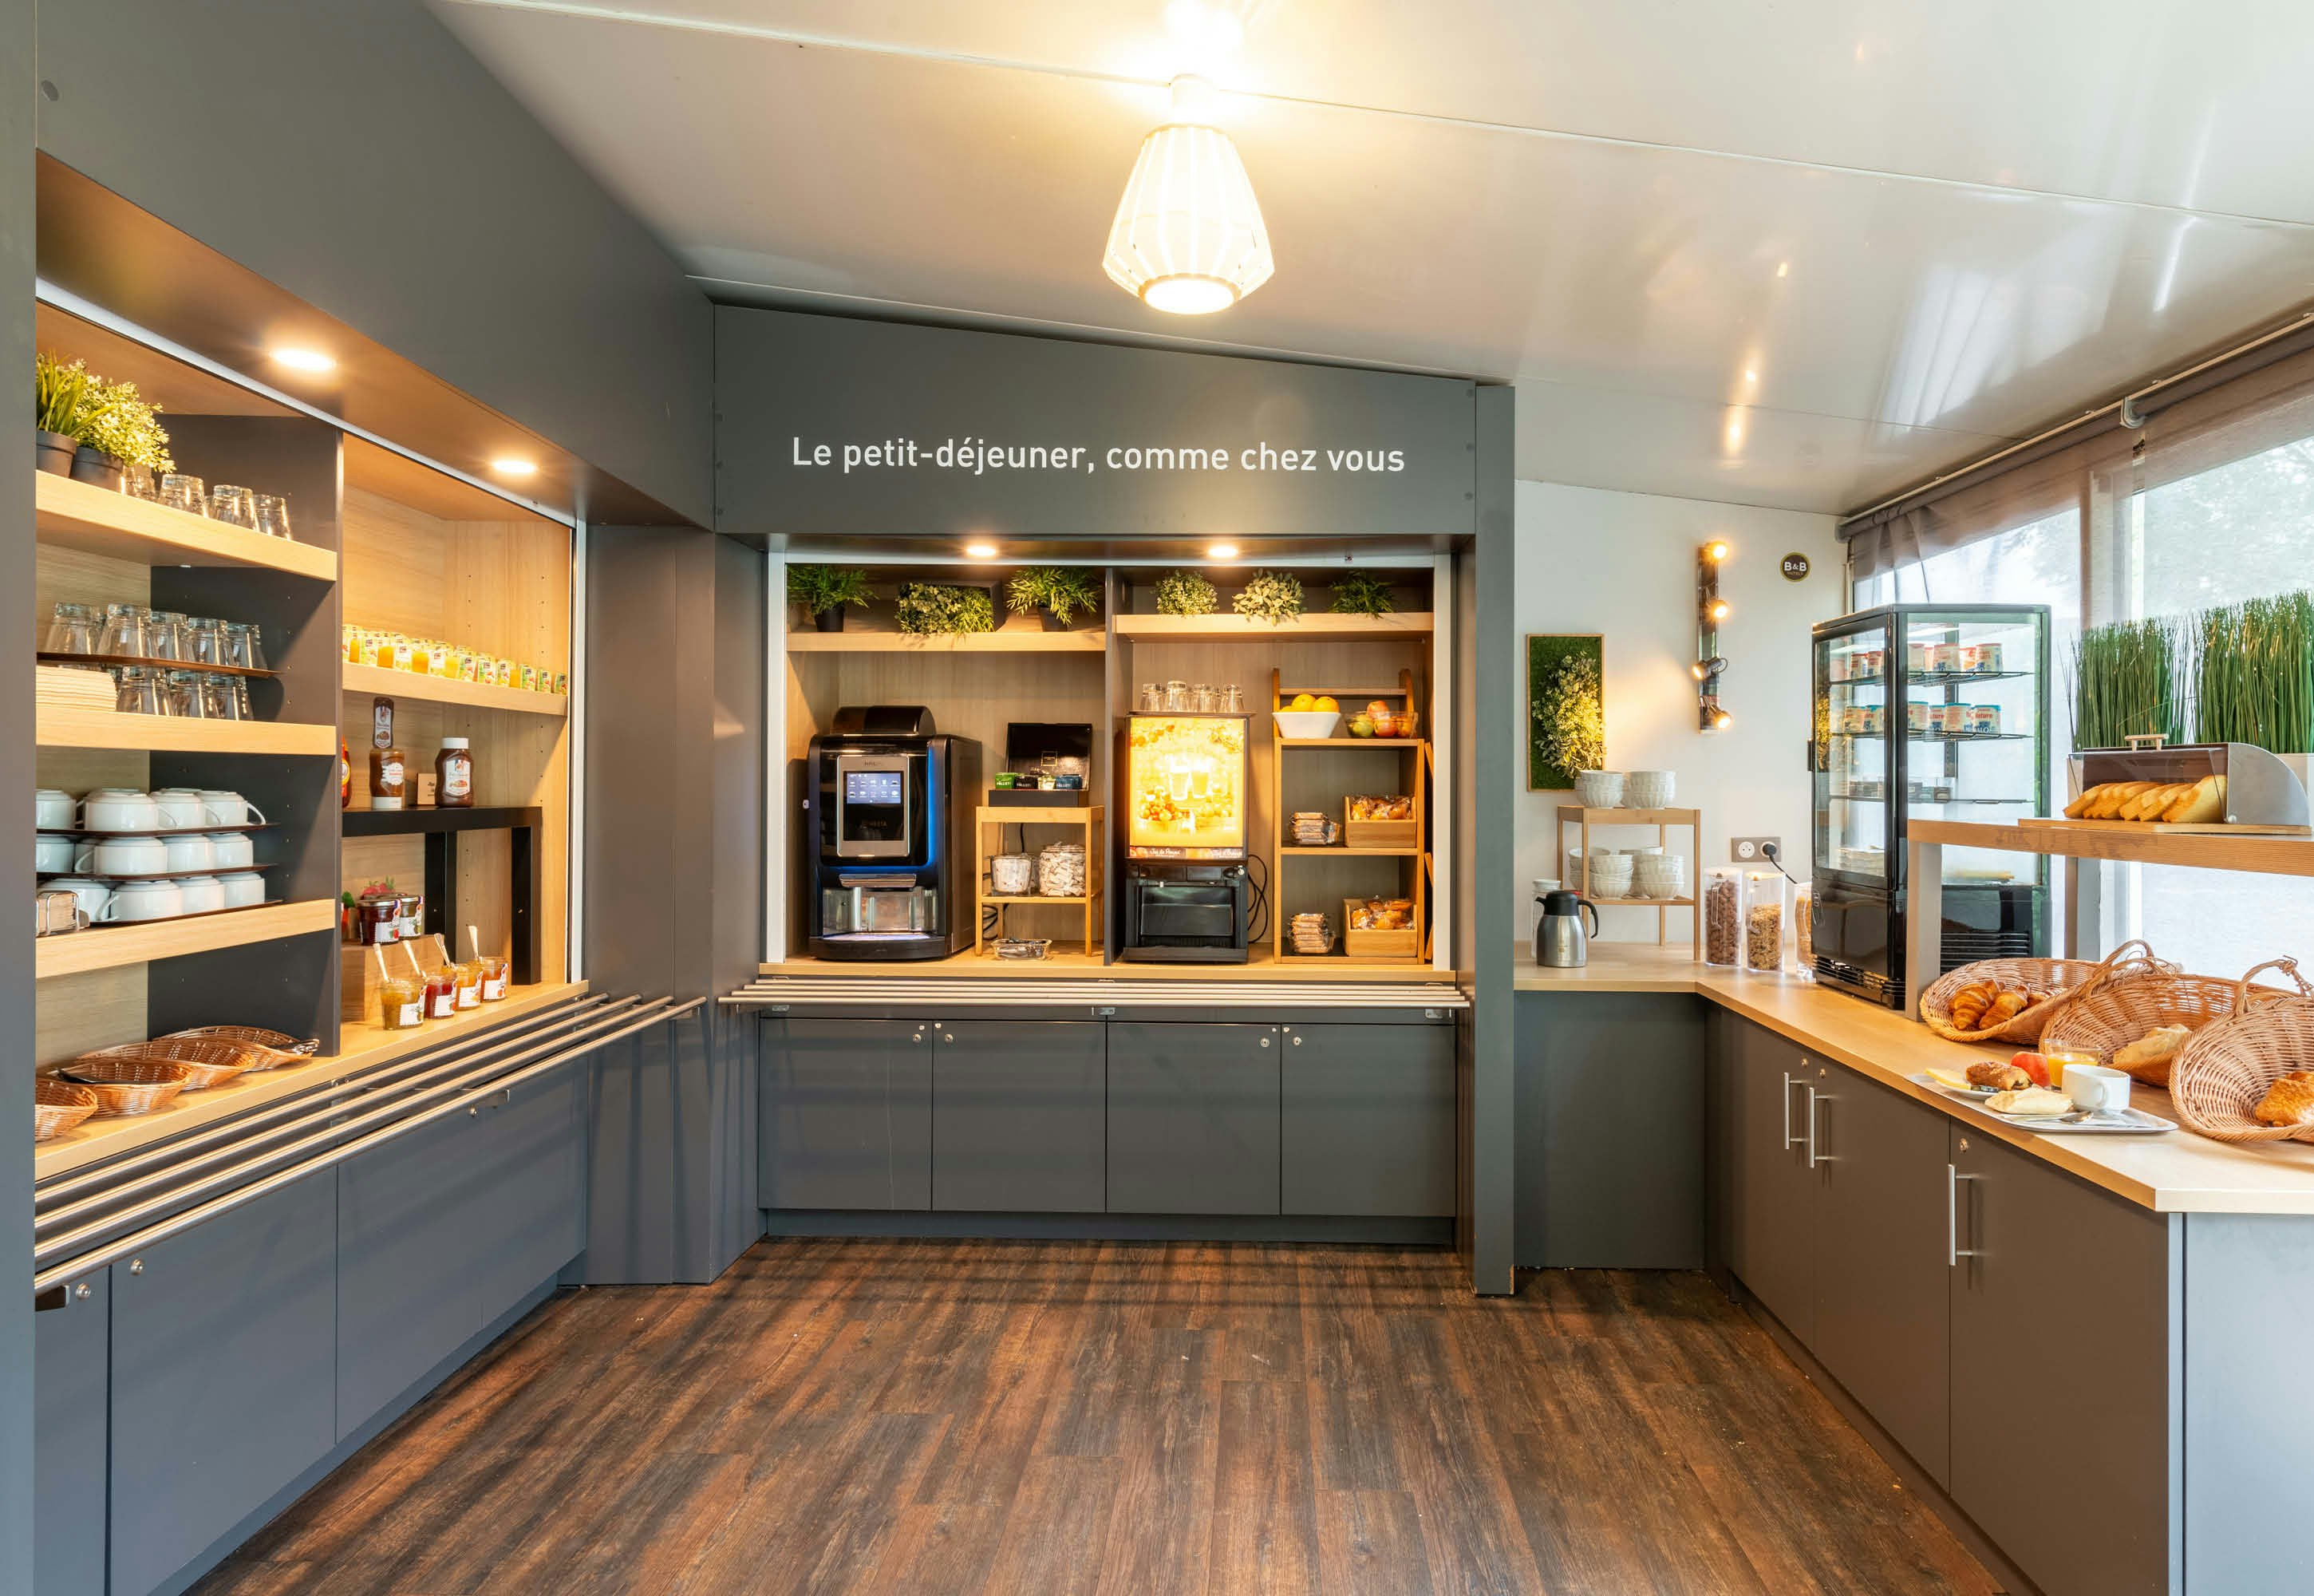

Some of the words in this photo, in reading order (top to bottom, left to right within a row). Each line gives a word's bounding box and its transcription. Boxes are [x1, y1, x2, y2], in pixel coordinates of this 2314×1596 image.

[792, 436, 832, 466] Le
[843, 436, 1094, 475] petit-déjeuner,
[1106, 446, 1230, 472] comme
[1239, 440, 1317, 472] chez
[1326, 448, 1405, 472] vous
[1784, 561, 1807, 571] B&B
